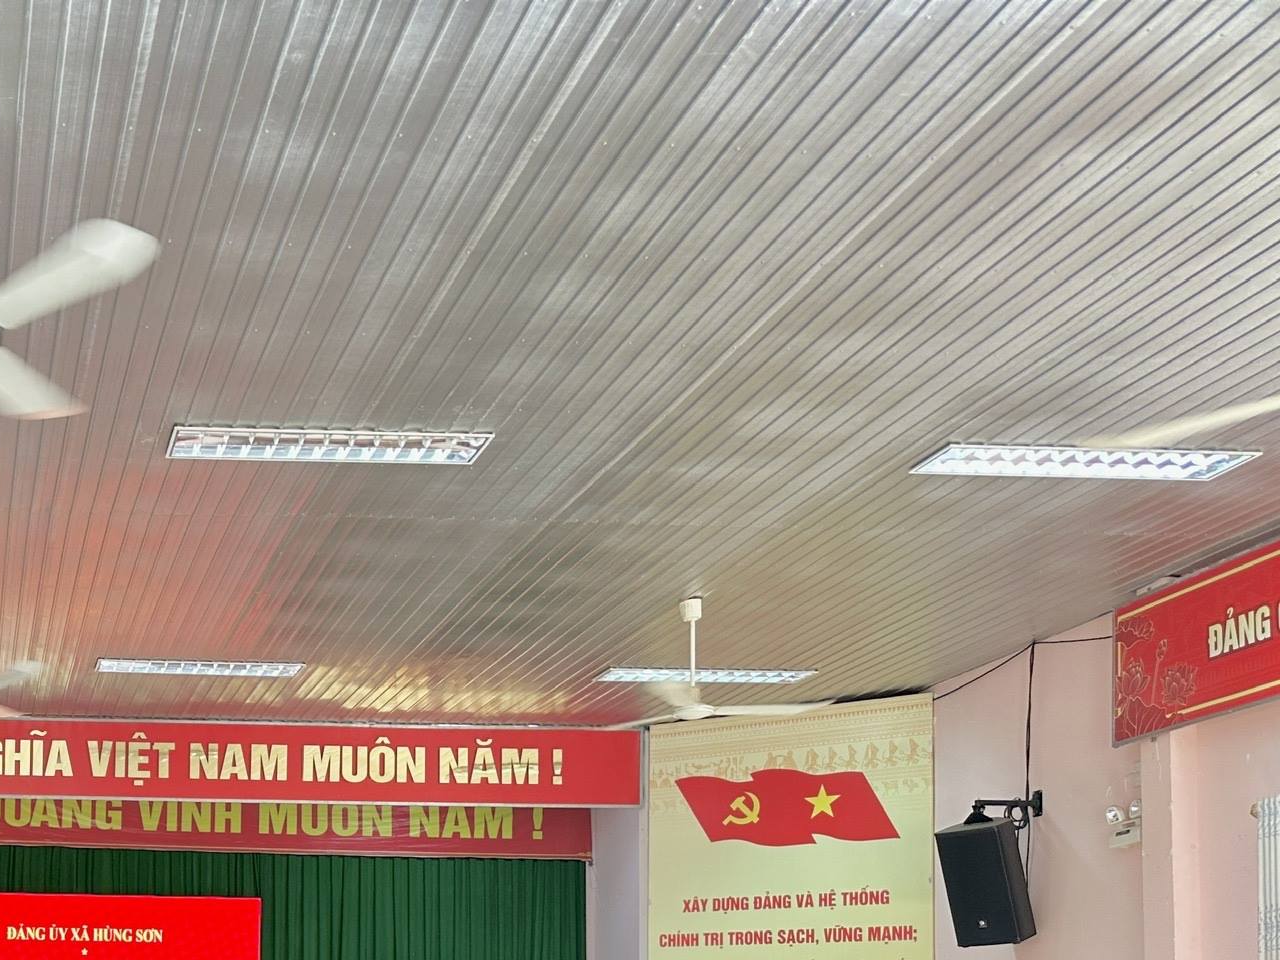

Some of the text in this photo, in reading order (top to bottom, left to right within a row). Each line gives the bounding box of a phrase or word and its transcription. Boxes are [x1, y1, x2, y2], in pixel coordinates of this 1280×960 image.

[1208, 606, 1272, 658] ĐẢNG
[87, 732, 175, 786] VIỆT
[189, 742, 288, 781] NAM
[302, 736, 425, 783] MUÔN
[439, 738, 539, 785] NĂM
[139, 800, 242, 834] VINH
[683, 885, 890, 914] XÂY DỰNG ĐẢNG VÀ HỆ THỐNG
[71, 925, 90, 941] XÃ
[93, 925, 132, 942] HÙNG
[136, 928, 163, 943] SƠN
[659, 925, 918, 949] CHÍNH TRỊ TRONG SẠCH, VỮNG MẠNH;
